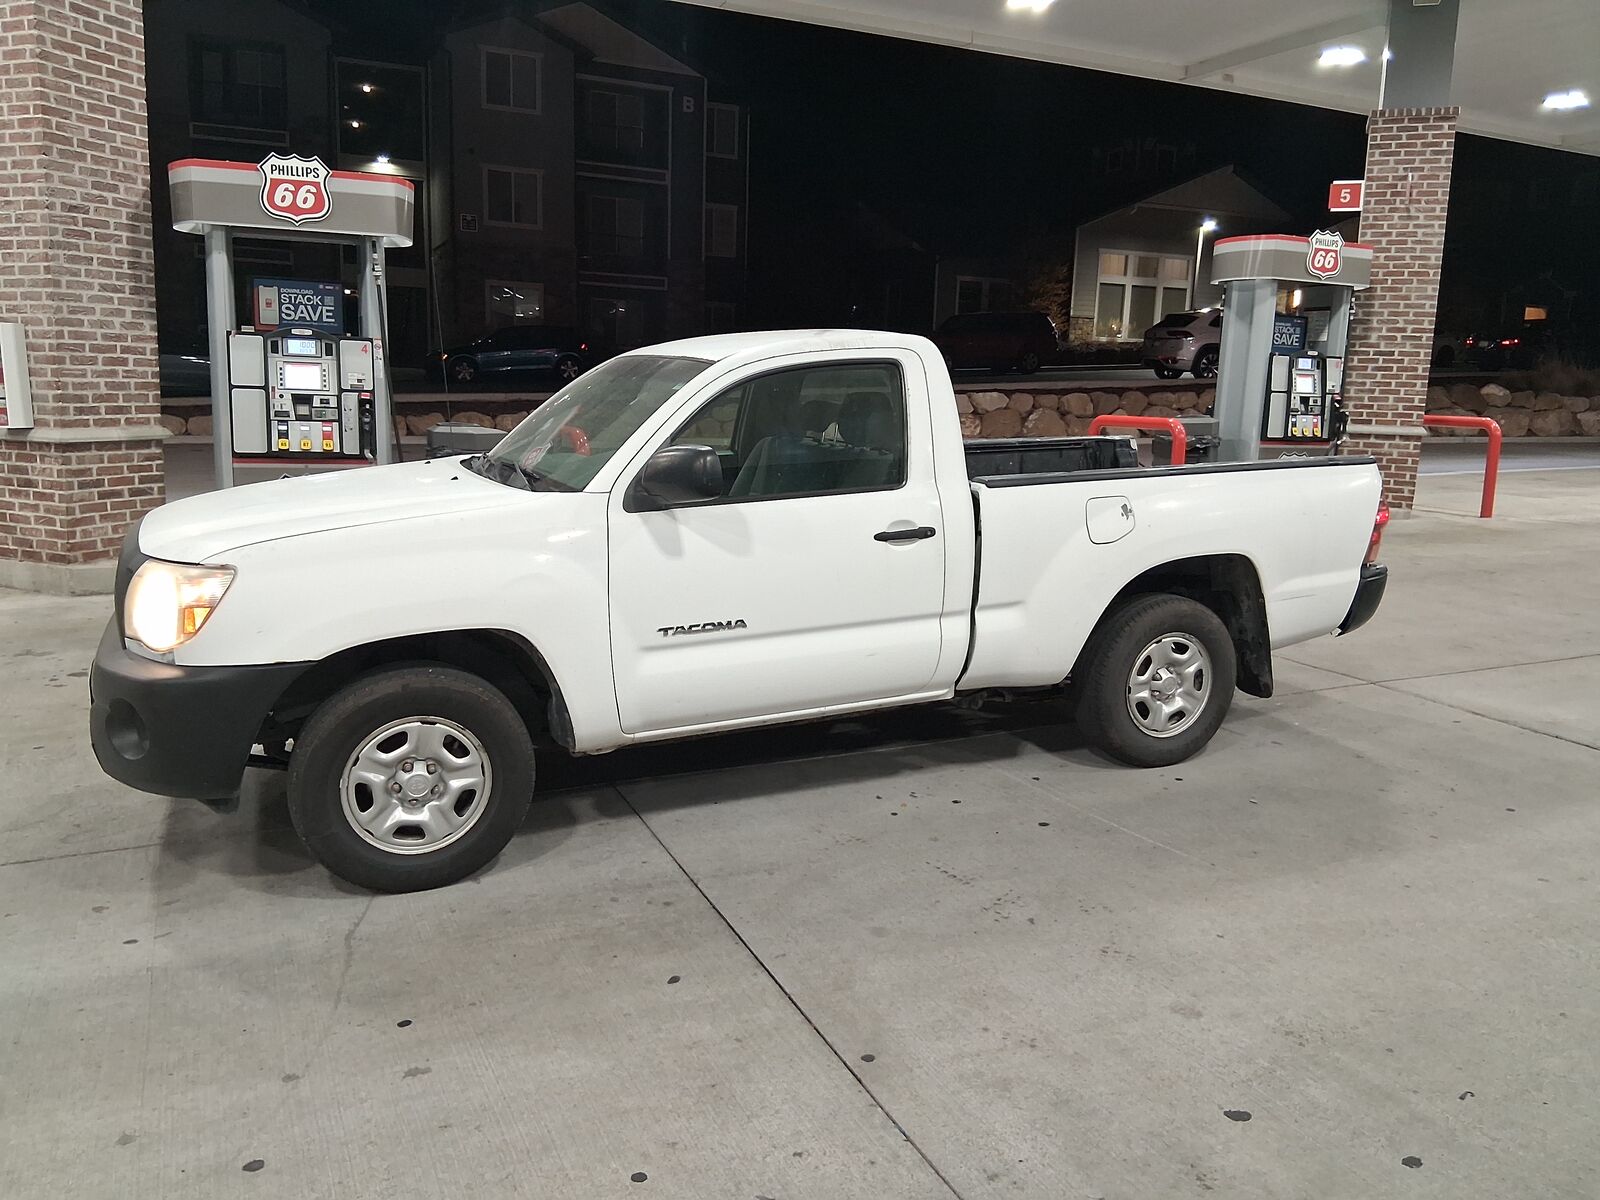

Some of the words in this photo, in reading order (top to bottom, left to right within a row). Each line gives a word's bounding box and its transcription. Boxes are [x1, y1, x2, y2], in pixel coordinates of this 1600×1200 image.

[682, 96, 695, 112] B
[270, 164, 320, 178] PHILLIPS
[274, 183, 317, 209] 66
[1339, 188, 1351, 203] 5
[1315, 237, 1339, 248] PHILLIPS
[1314, 250, 1336, 269] 66
[280, 287, 314, 295] DOWNLOAD
[280, 293, 322, 306] STACK
[281, 303, 335, 322] SAVE
[1274, 326, 1295, 334] STACK
[1273, 333, 1300, 346] SAVE
[361, 344, 369, 354] 4
[656, 619, 748, 637] TACOMA
